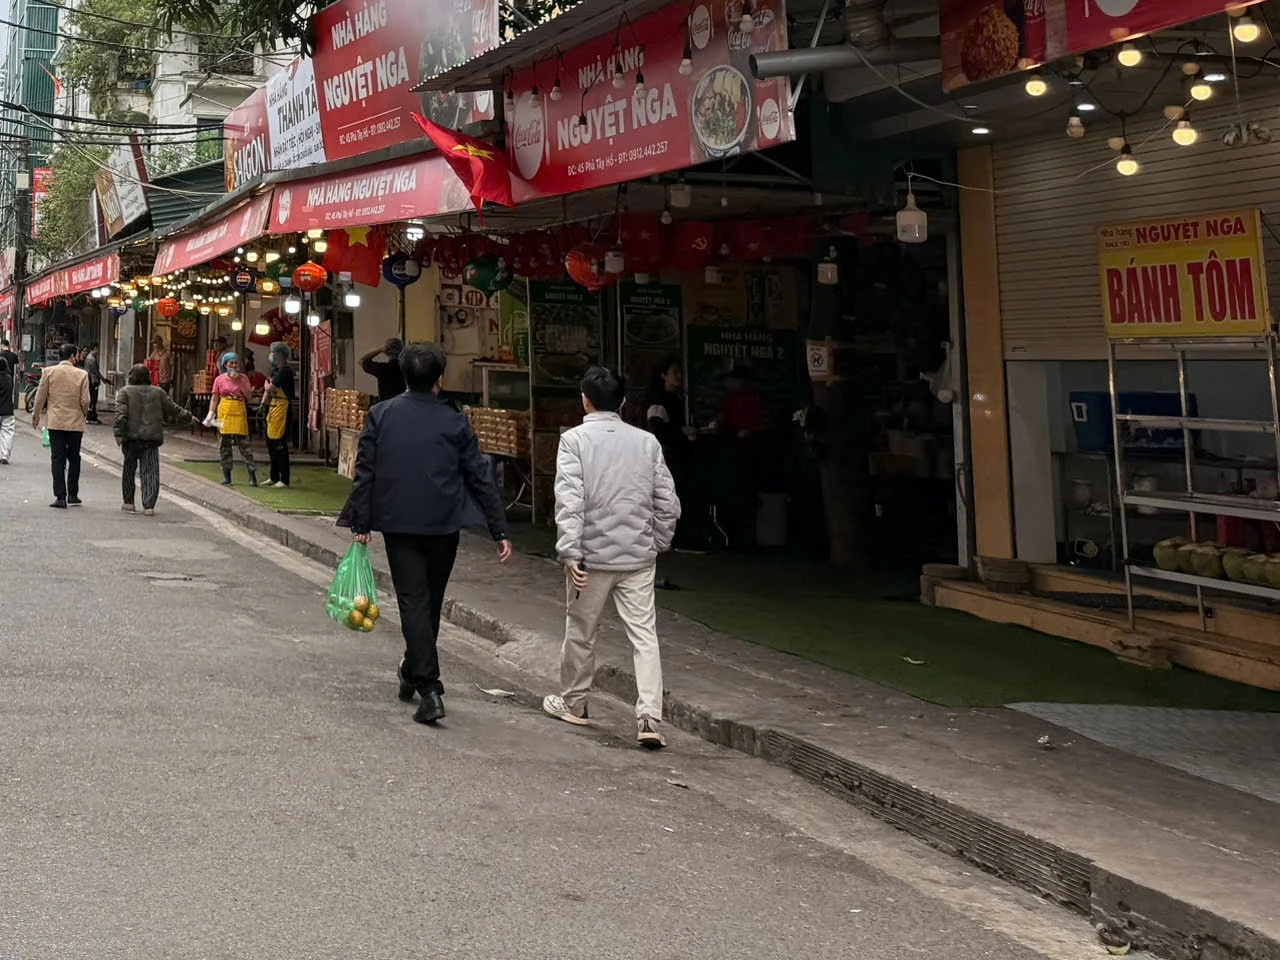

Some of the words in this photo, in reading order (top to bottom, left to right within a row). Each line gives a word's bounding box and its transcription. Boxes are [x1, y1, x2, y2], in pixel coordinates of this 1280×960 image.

[331, 8, 354, 50] NHÀ
[354, 0, 387, 39] HÀNG
[323, 56, 373, 111] NGUYỆT
[375, 46, 410, 92] NGA
[578, 55, 605, 89] NHÀ
[277, 90, 305, 135] THANH
[304, 74, 318, 118] TÂ
[557, 94, 628, 151] NGUYỆT
[631, 82, 677, 130] NGA
[233, 133, 266, 190] SAIGON
[577, 162, 585, 172] 45
[585, 159, 596, 172] Phủ
[595, 156, 605, 171] Tây
[605, 154, 614, 167] Hồ
[628, 140, 669, 161] 0912.442.257
[306, 181, 326, 208] NHÀ
[326, 178, 352, 205] HÀNG
[351, 169, 394, 202] NGUYỆT
[393, 167, 417, 194] NGA
[1135, 218, 1200, 244] NGUYỆT
[1205, 216, 1246, 238] NGA
[1106, 256, 1182, 324] BÁNH
[1187, 249, 1257, 322] TÔM
[776, 346, 785, 360] 2
